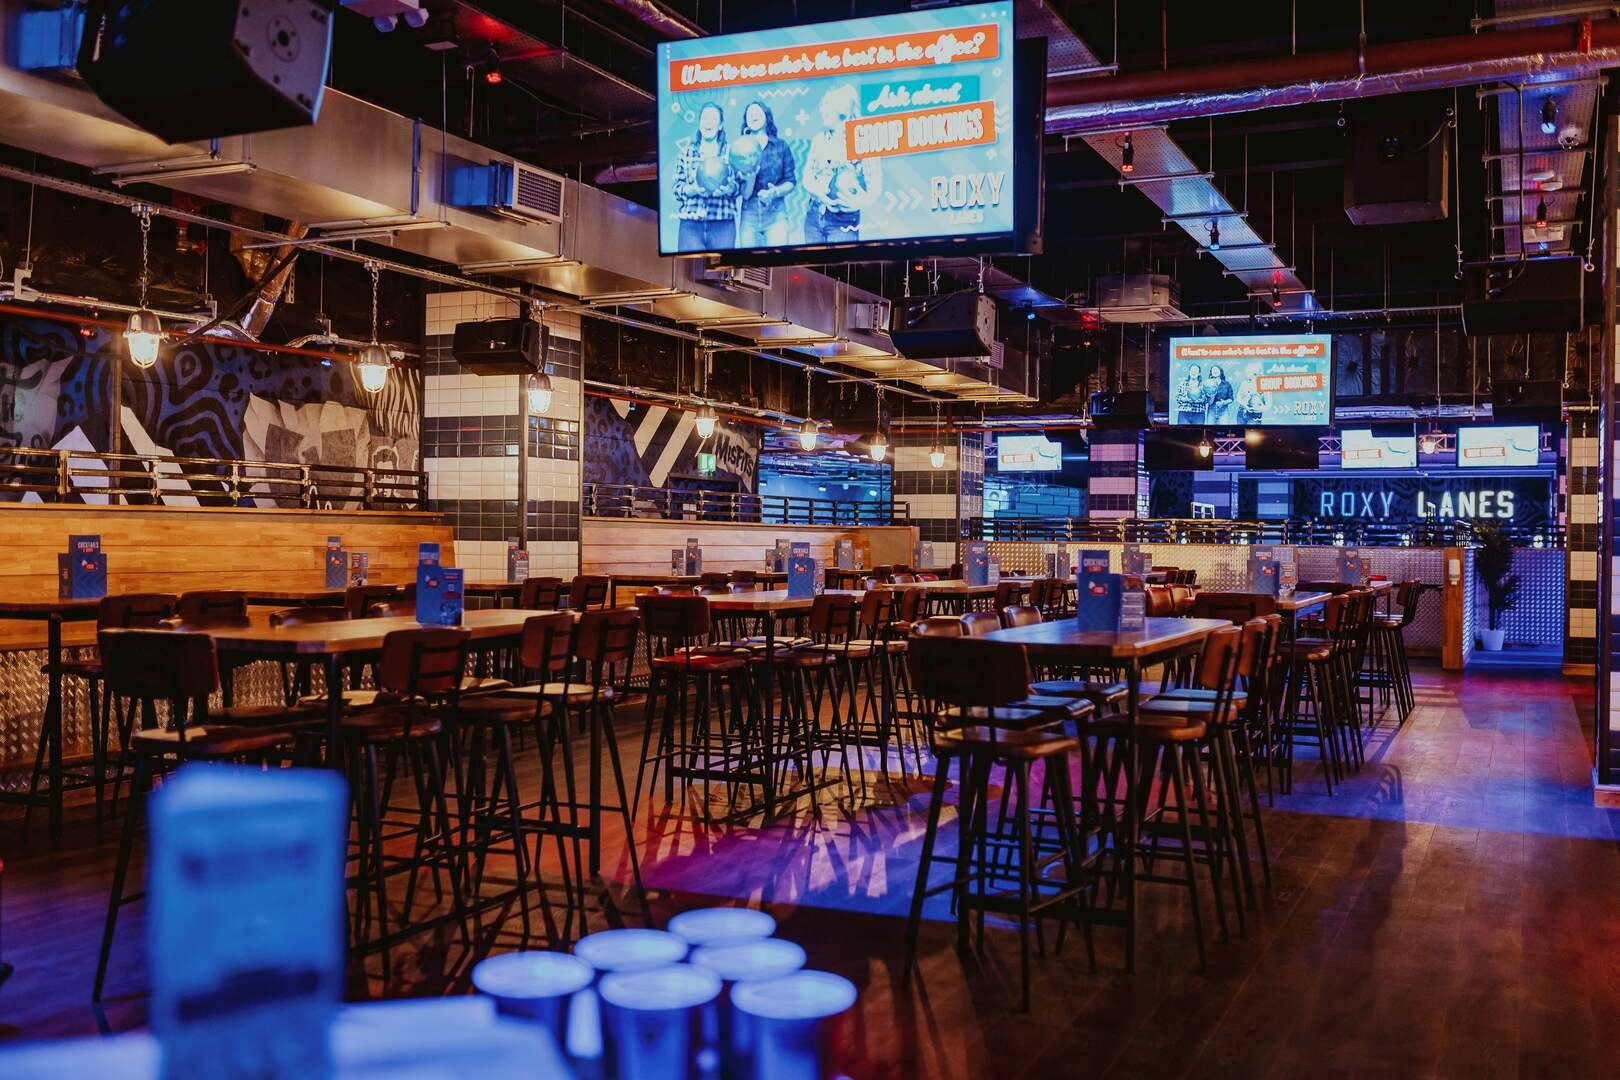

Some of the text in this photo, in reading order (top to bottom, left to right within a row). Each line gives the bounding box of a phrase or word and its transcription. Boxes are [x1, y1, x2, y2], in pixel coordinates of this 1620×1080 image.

[681, 64, 722, 85] Want
[721, 62, 740, 81] to
[740, 63, 767, 79] see
[815, 50, 841, 71] the
[842, 46, 877, 67] best
[877, 46, 895, 64] in
[895, 41, 924, 62] the
[925, 32, 986, 65] office?
[867, 82, 962, 112] Ask about
[854, 108, 985, 155] GROUP BOOKINGS
[931, 172, 1005, 211] ROXY
[1294, 400, 1326, 416] ROXY
[1320, 490, 1515, 519] ROXY LANES
